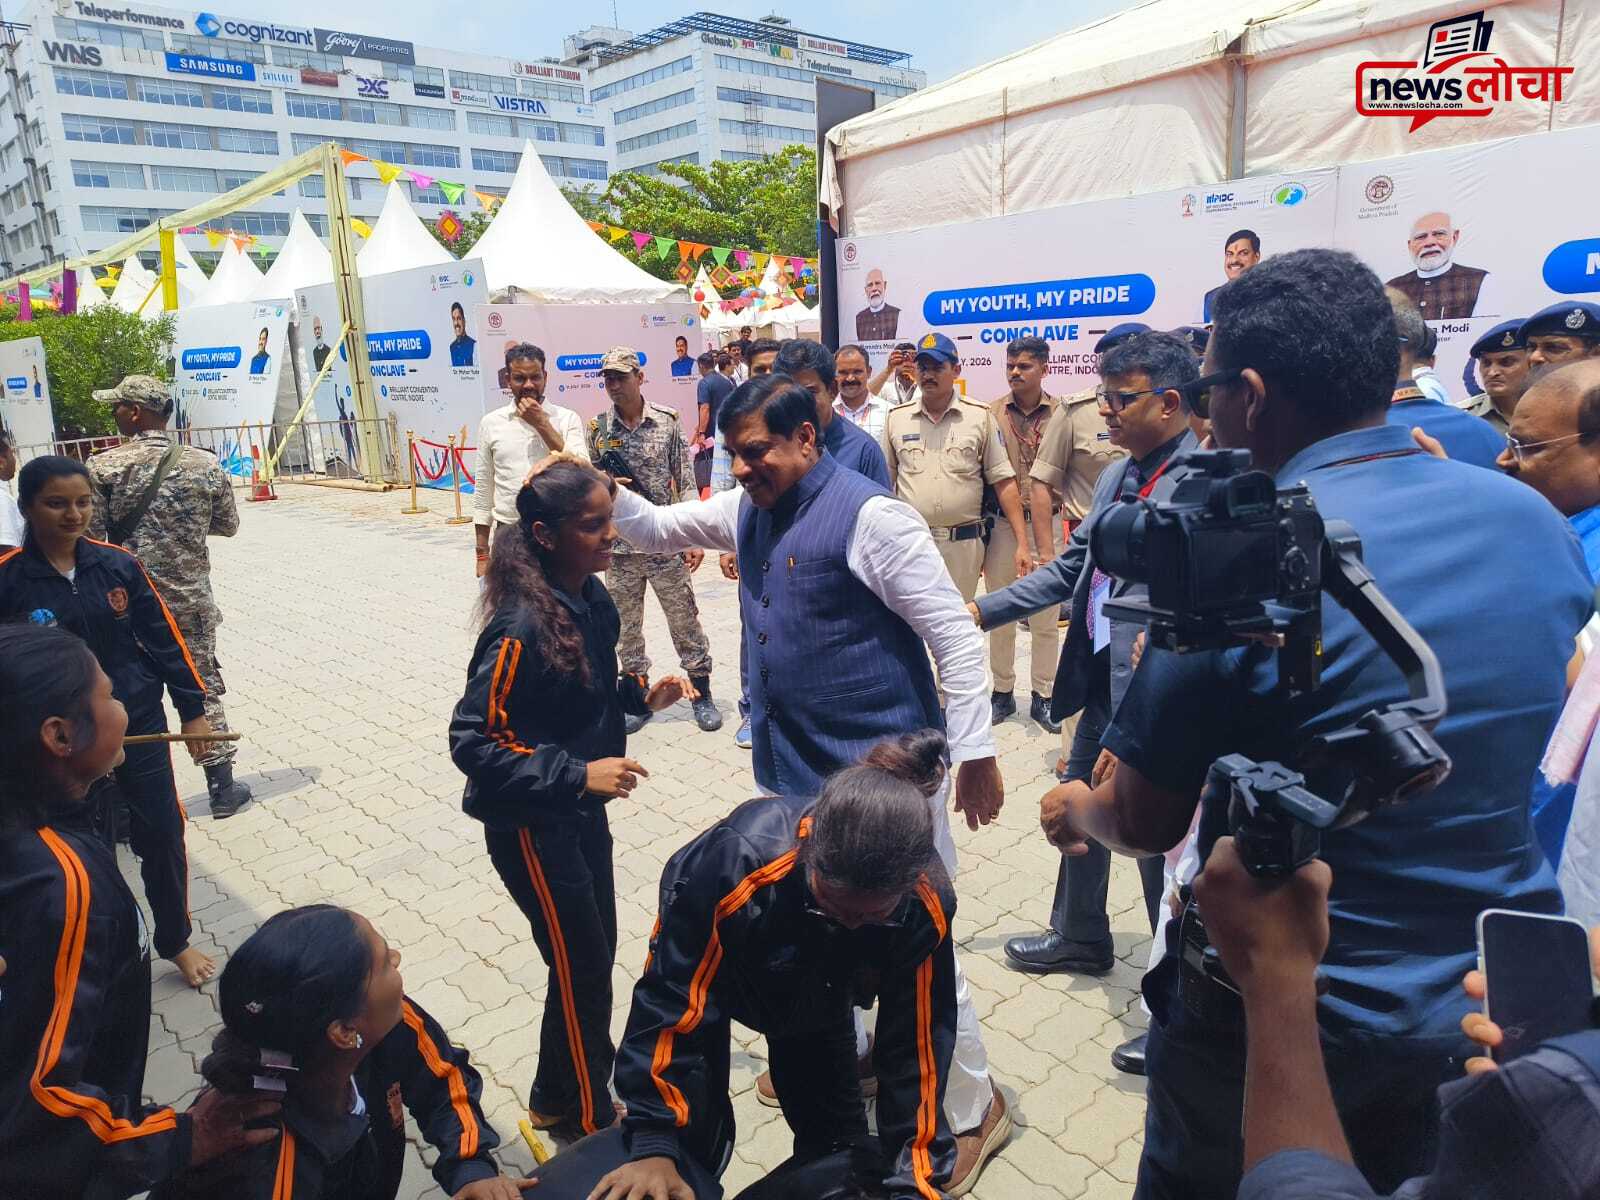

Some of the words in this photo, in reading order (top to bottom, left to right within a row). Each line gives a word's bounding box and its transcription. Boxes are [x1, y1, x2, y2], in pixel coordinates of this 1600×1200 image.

[75, 1, 184, 30] Teleperformance
[224, 21, 314, 46] cognizant
[42, 40, 103, 67] WNS
[179, 57, 244, 75] SAMSUNG
[356, 77, 389, 96] DXC
[493, 95, 547, 114] VISTRA
[941, 299, 968, 315] MY
[968, 294, 1032, 313] YOUTH,
[1036, 289, 1068, 308] MY
[1068, 285, 1131, 305] PRIDE
[980, 324, 1079, 344] CONCLAVE
[1441, 323, 1470, 334] Modi
[397, 338, 422, 351] PRIDE
[370, 364, 406, 377] ONCLAVE
[970, 357, 992, 366] 2026
[1046, 365, 1073, 376] NTRE,
[1074, 365, 1098, 375] INDO
